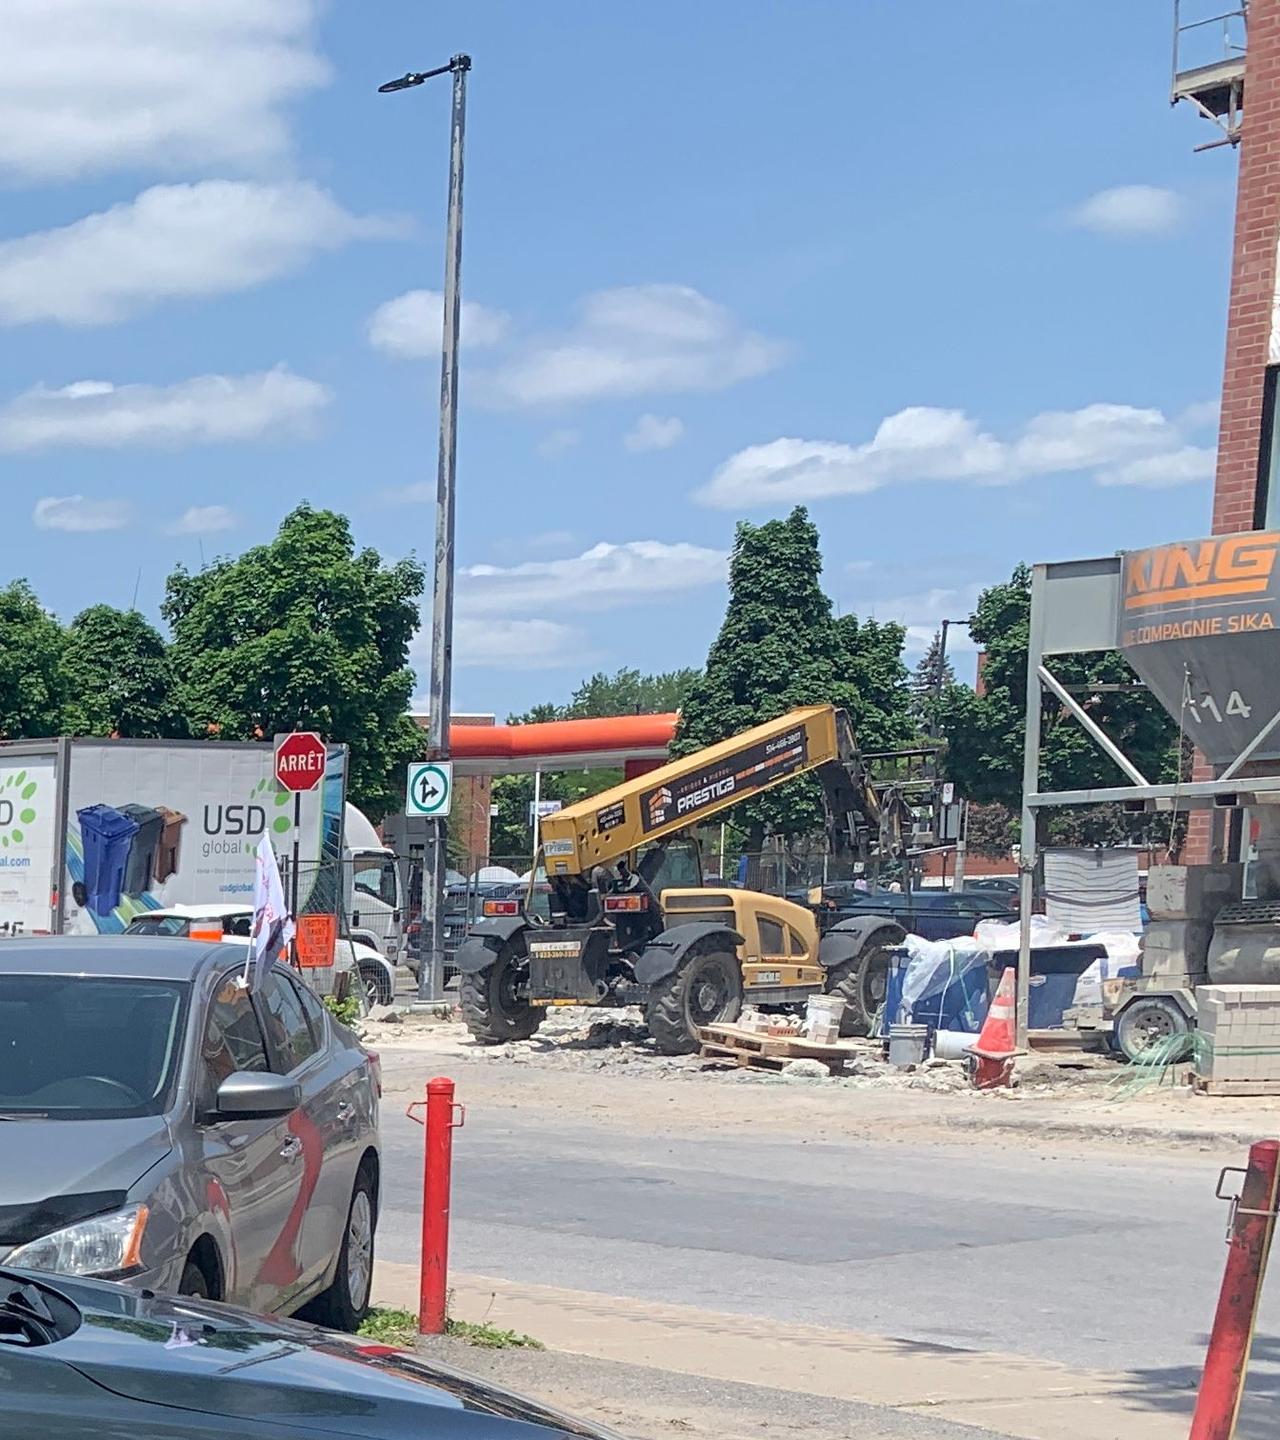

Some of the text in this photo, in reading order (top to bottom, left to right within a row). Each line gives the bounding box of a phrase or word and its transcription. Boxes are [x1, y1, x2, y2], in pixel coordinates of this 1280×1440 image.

[1127, 534, 1280, 593] KING
[1138, 617, 1223, 644] COMPAGNIE
[1228, 613, 1273, 632] SIKA
[279, 751, 323, 772] ARRÊT
[204, 805, 265, 835] USD
[202, 841, 241, 857] global
